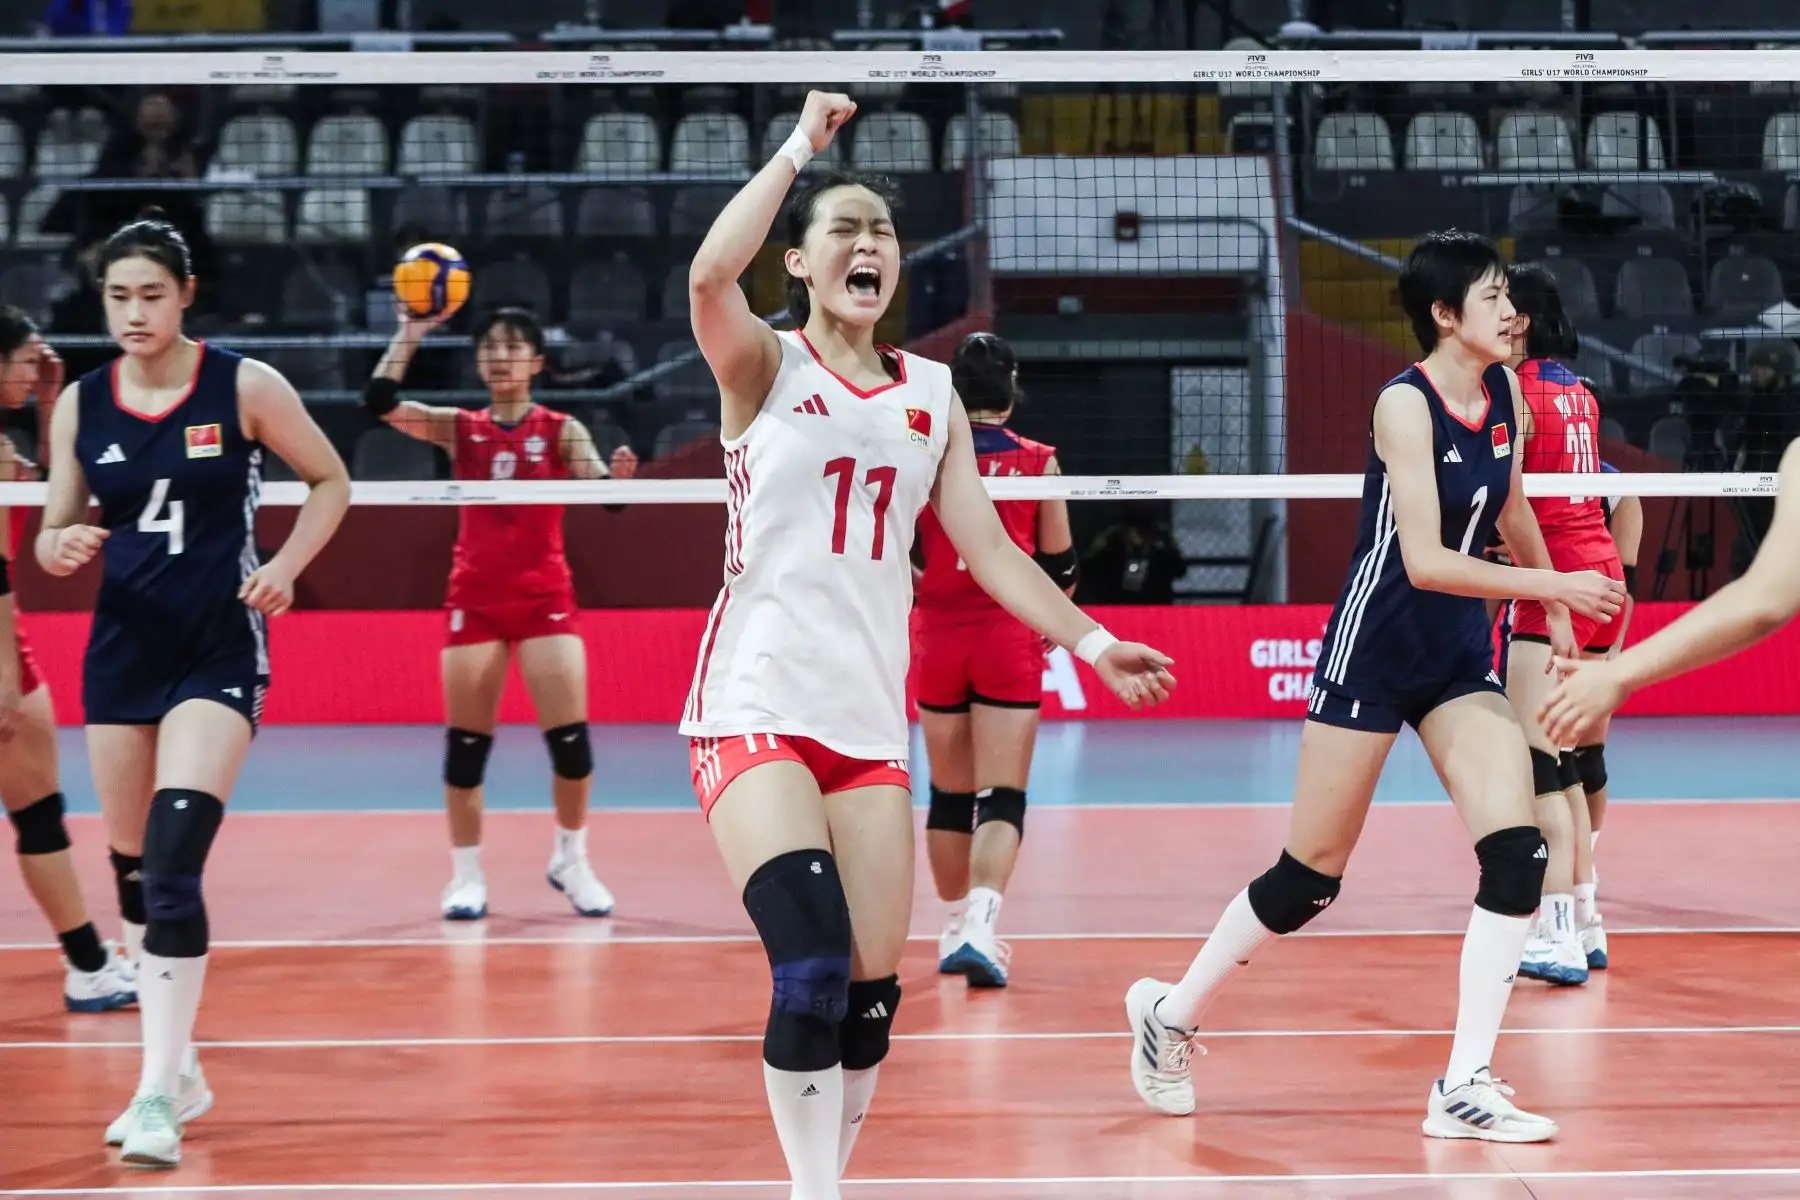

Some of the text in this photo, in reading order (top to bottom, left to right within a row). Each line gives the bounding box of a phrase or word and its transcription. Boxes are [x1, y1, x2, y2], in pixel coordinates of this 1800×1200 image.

[1247, 54, 1266, 62] FIVB
[1575, 53, 1594, 61] FIVB
[910, 70, 937, 78] WORLD
[939, 70, 997, 78] CHAMPIONSHIP
[1193, 69, 1321, 78] GIRLS' U17 WORLD CHAMPIONSHIP
[1521, 69, 1649, 77] GIRLS' U17 WORLD CHAMPIONSHIP
[910, 432, 928, 447] CHN
[823, 456, 898, 561] 11
[137, 477, 184, 555] 4
